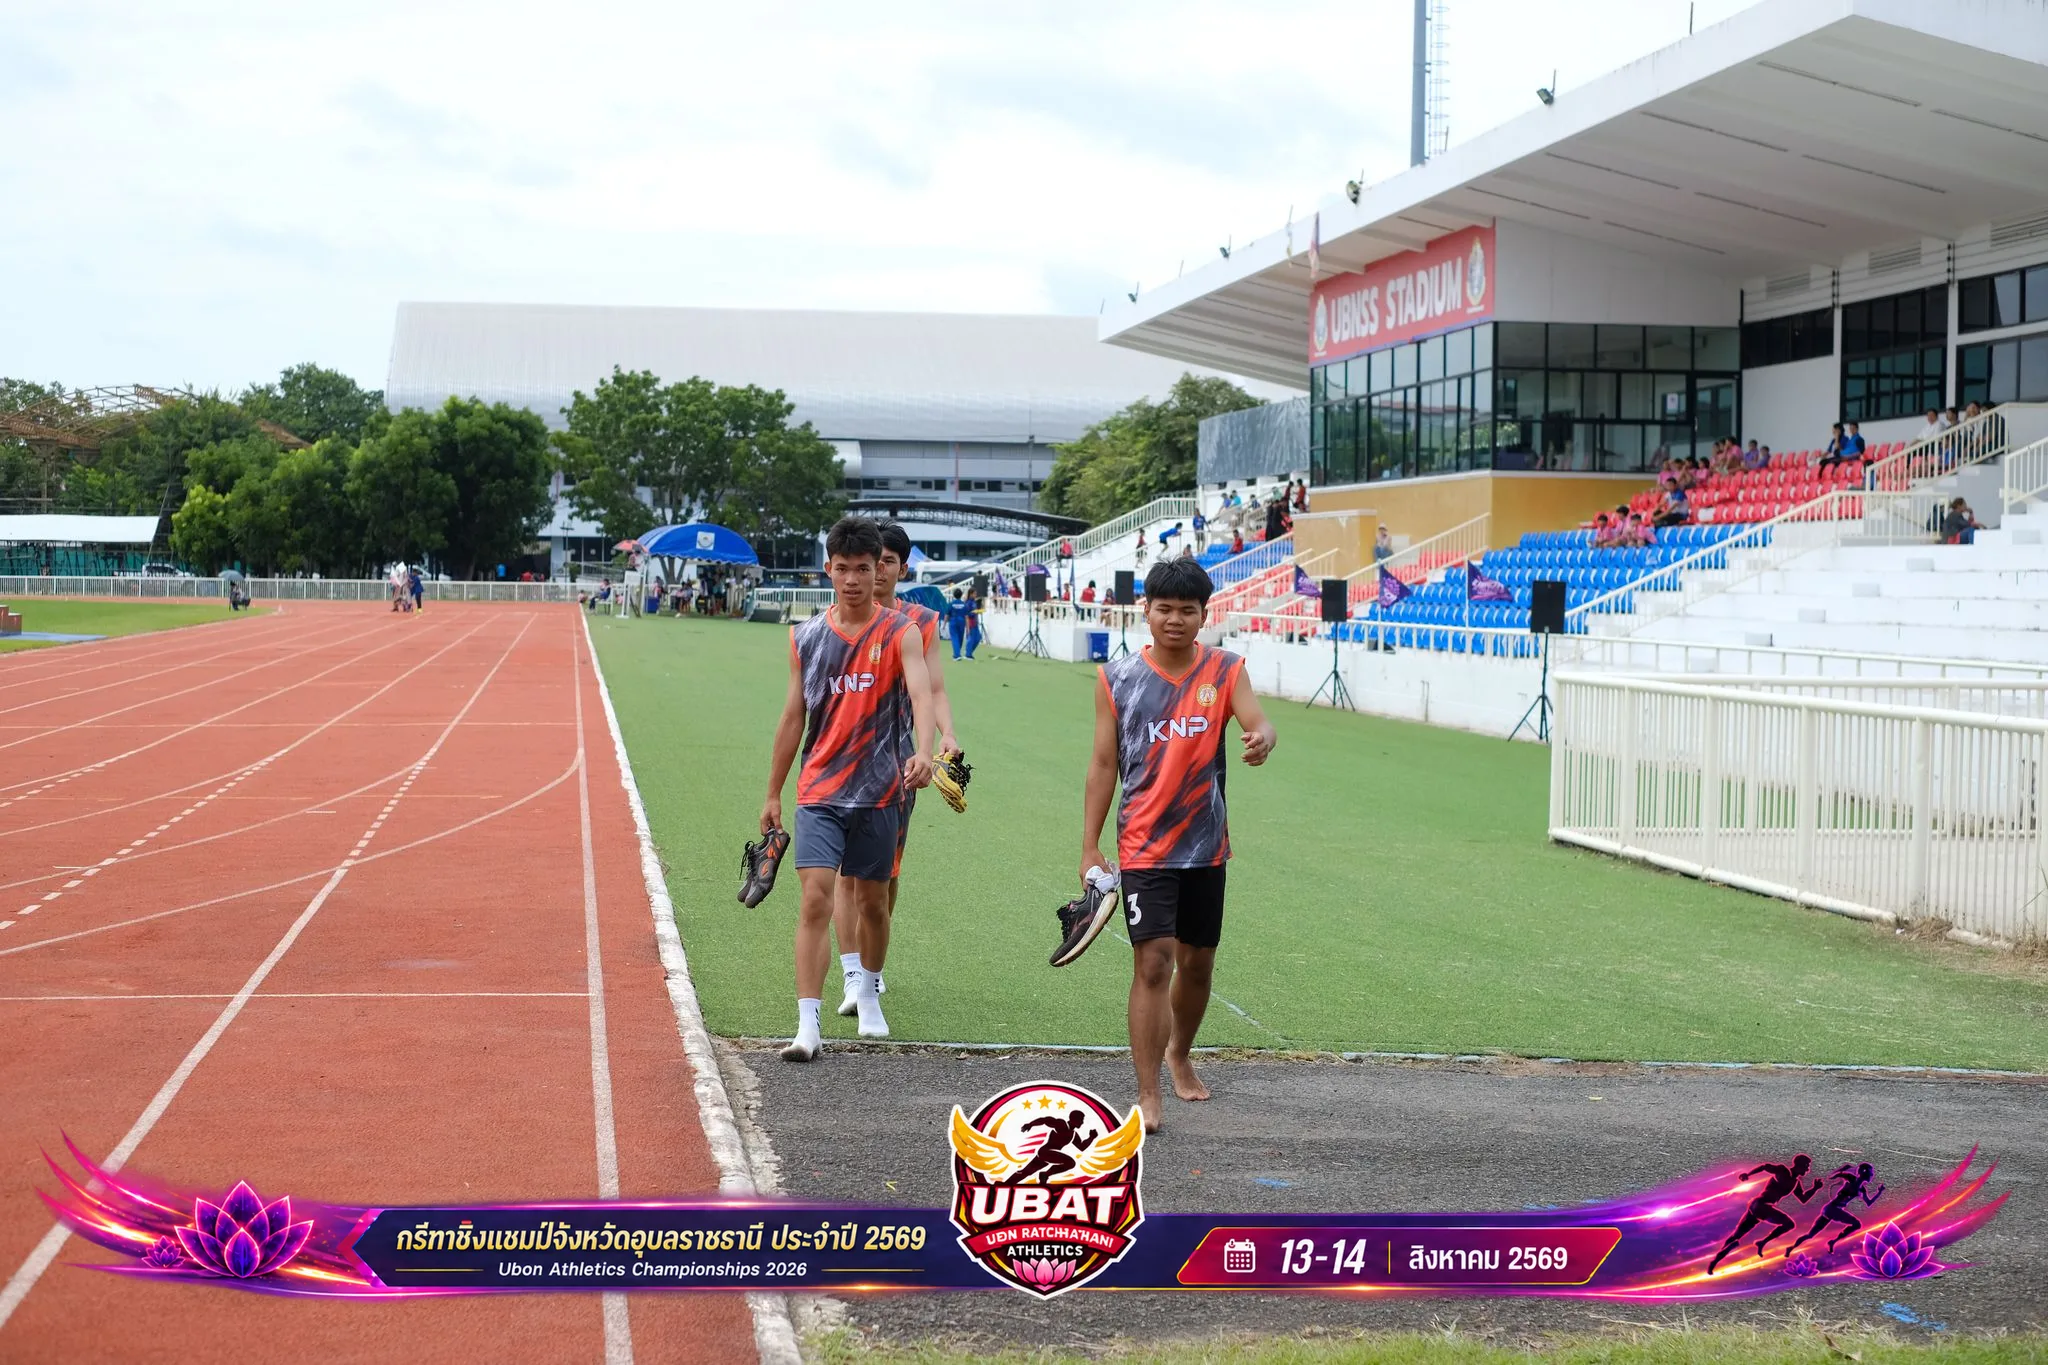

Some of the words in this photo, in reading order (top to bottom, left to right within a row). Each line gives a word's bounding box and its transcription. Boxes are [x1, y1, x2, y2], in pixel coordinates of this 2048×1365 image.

[1331, 286, 1379, 345] UBNSS
[1386, 256, 1463, 331] STADIUM
[828, 672, 876, 695] KNP
[1147, 715, 1209, 744] KNP
[1127, 892, 1142, 926] 3
